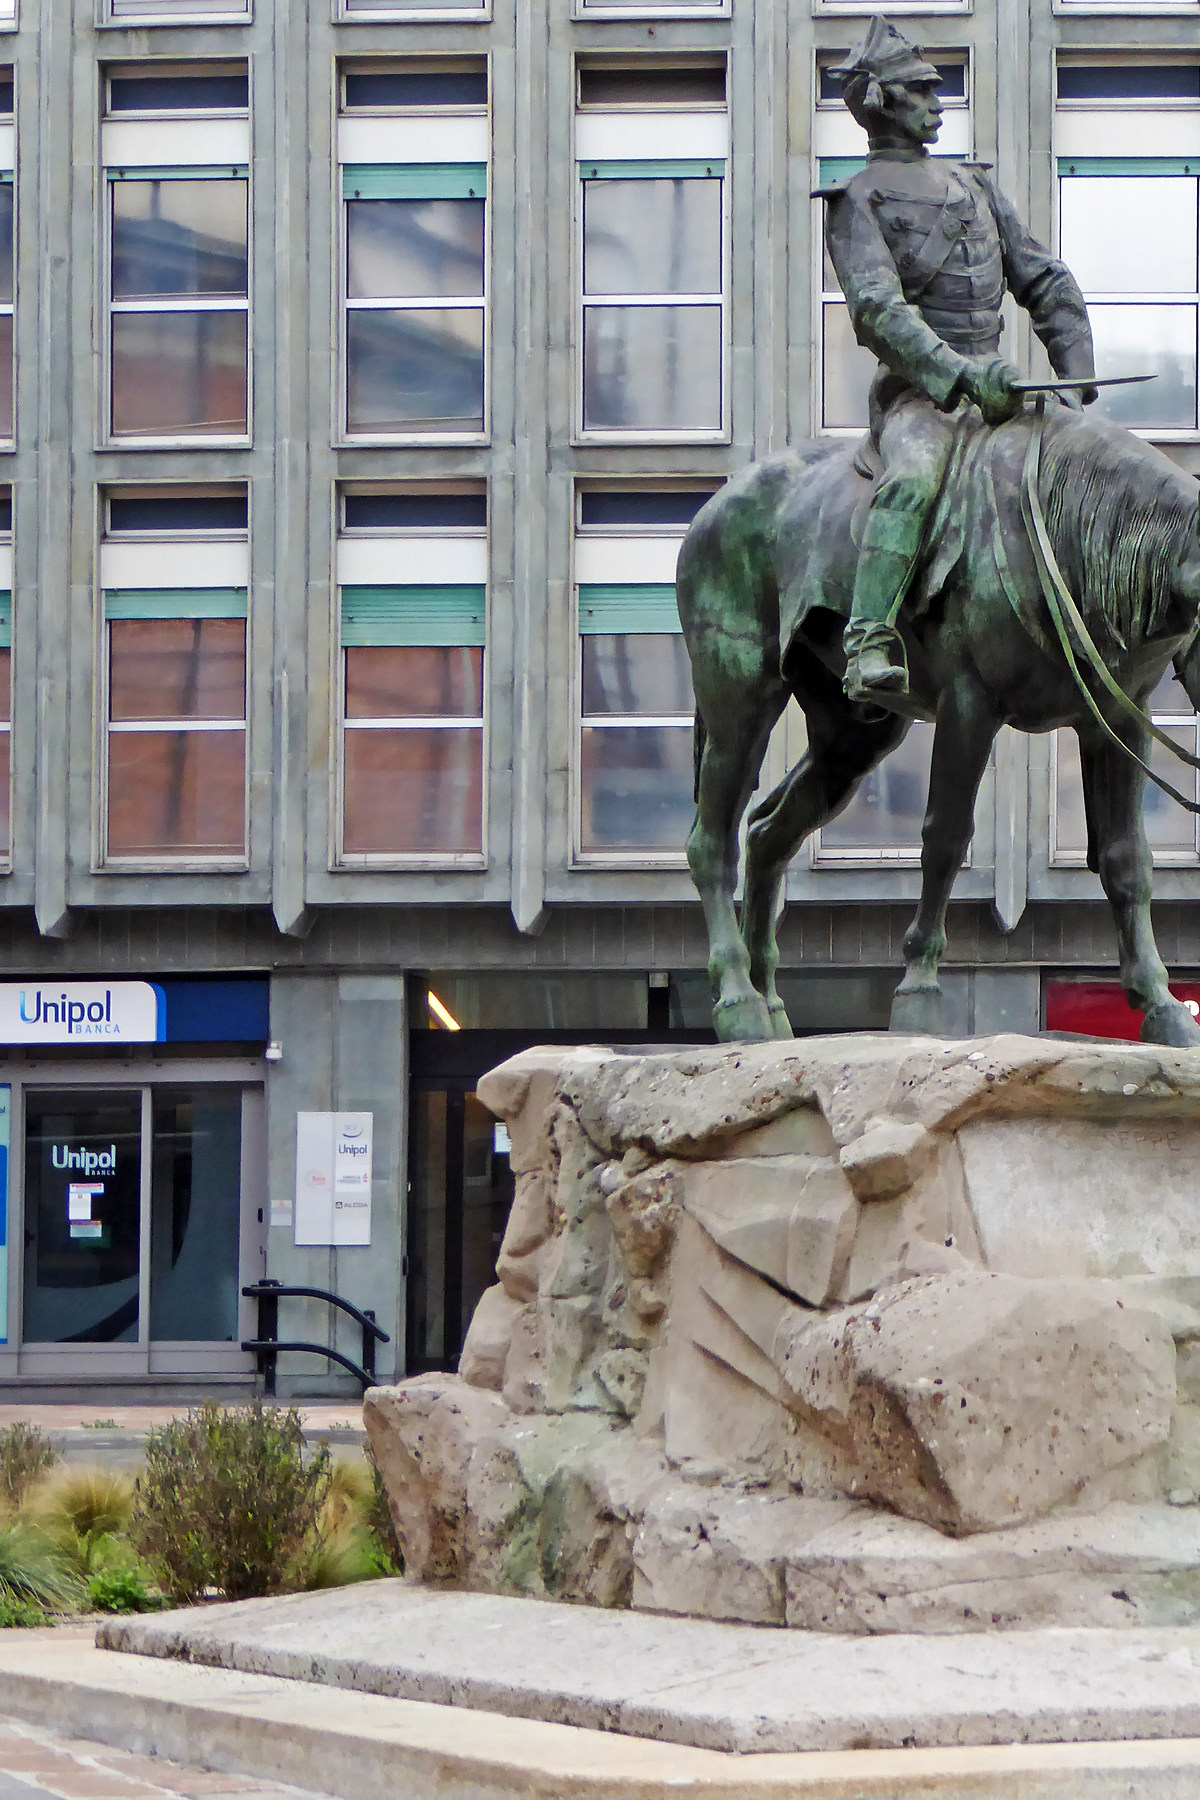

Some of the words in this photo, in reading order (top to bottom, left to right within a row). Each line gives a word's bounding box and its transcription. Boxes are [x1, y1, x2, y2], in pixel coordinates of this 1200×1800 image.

[20, 990, 111, 1034] Unipol
[75, 1024, 121, 1034] BANCA
[52, 1144, 117, 1176] Unipol
[338, 1144, 368, 1157] Unipol
